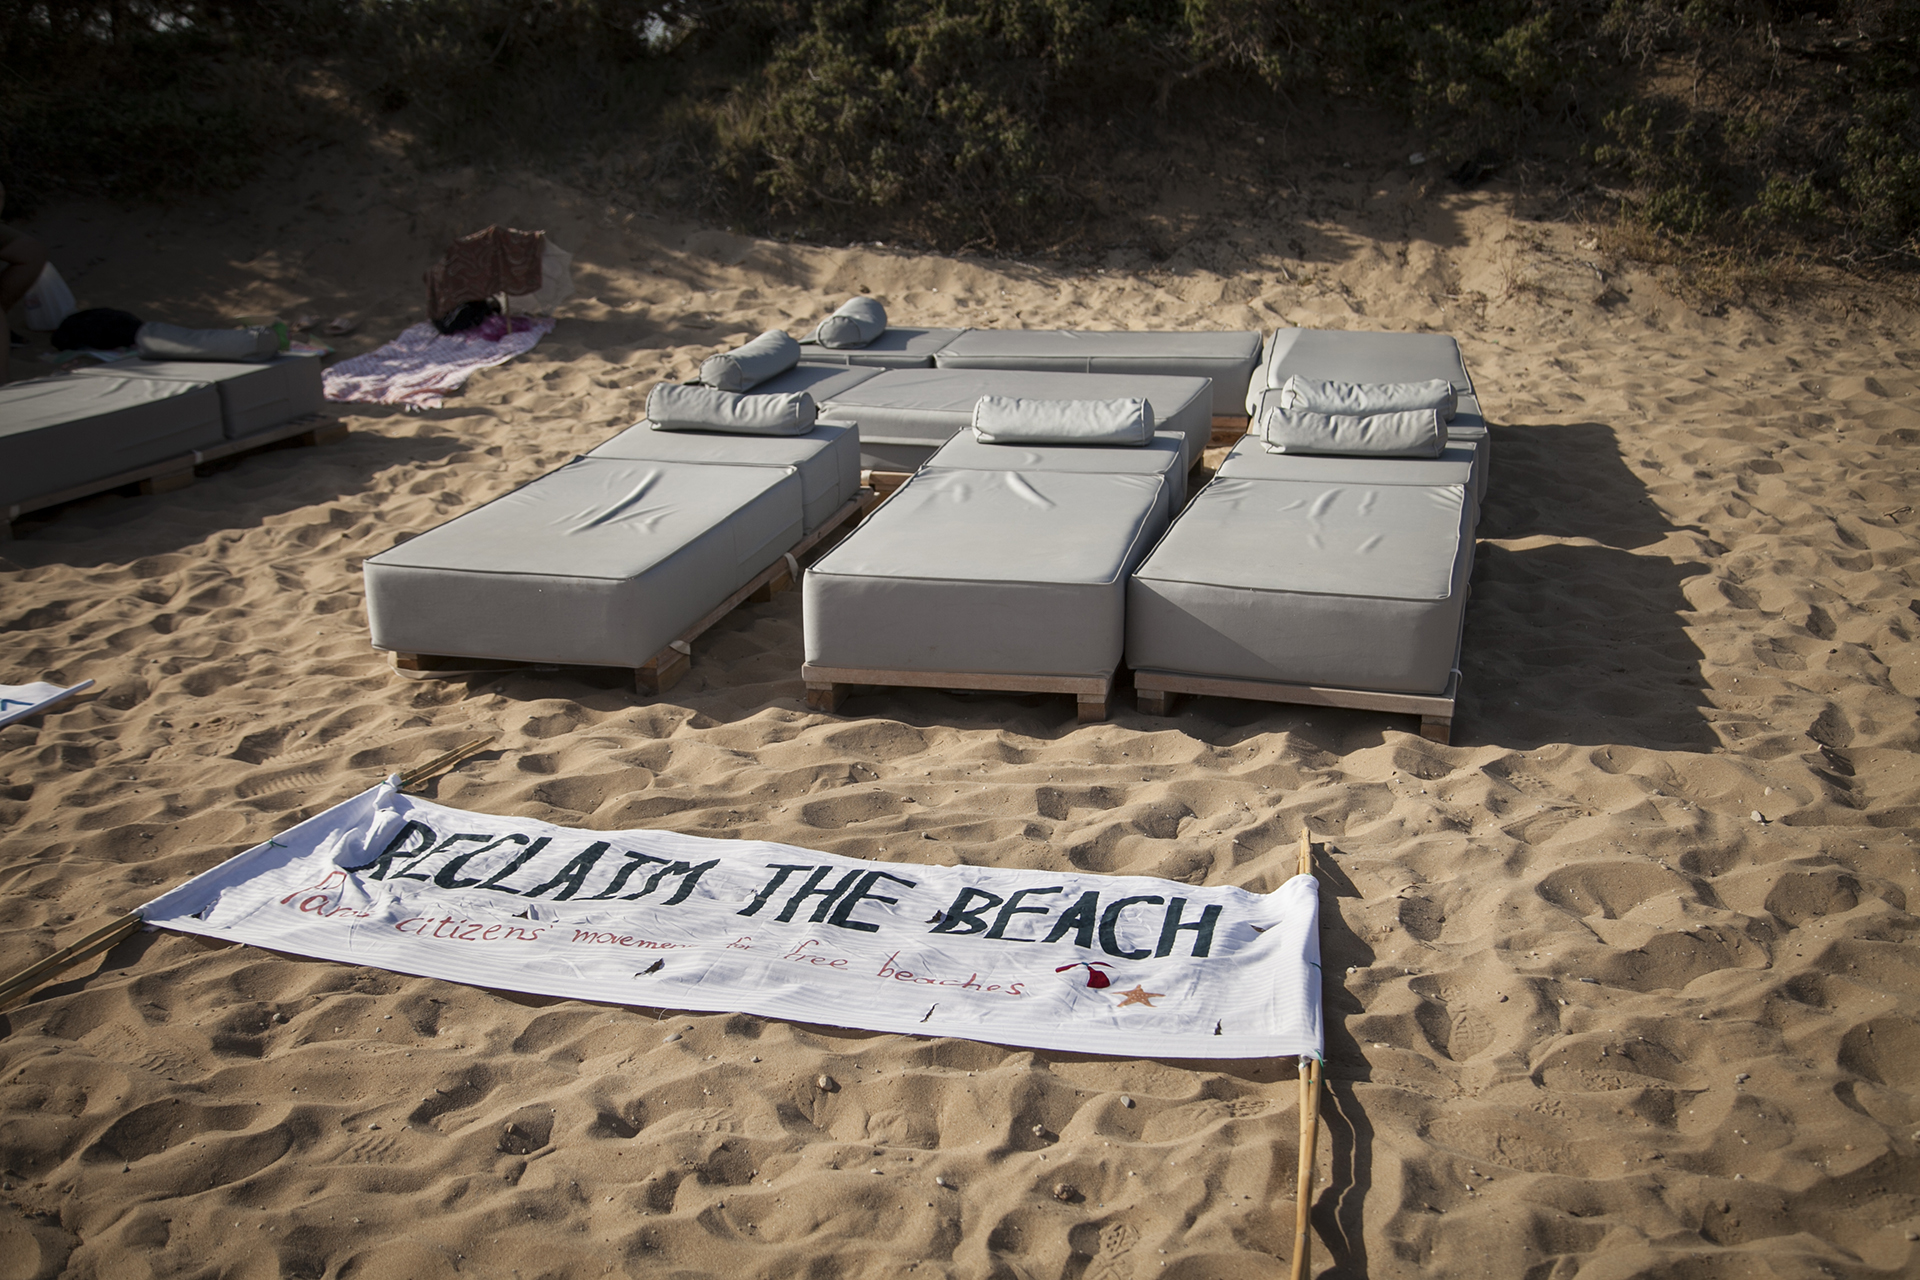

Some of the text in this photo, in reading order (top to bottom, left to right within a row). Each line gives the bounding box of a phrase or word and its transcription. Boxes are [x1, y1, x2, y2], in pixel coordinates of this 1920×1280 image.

[342, 819, 1223, 961] RECLAIM THE BEACH
[726, 936, 755, 950] for
[783, 939, 849, 971] free
[877, 949, 1025, 996] beaches
